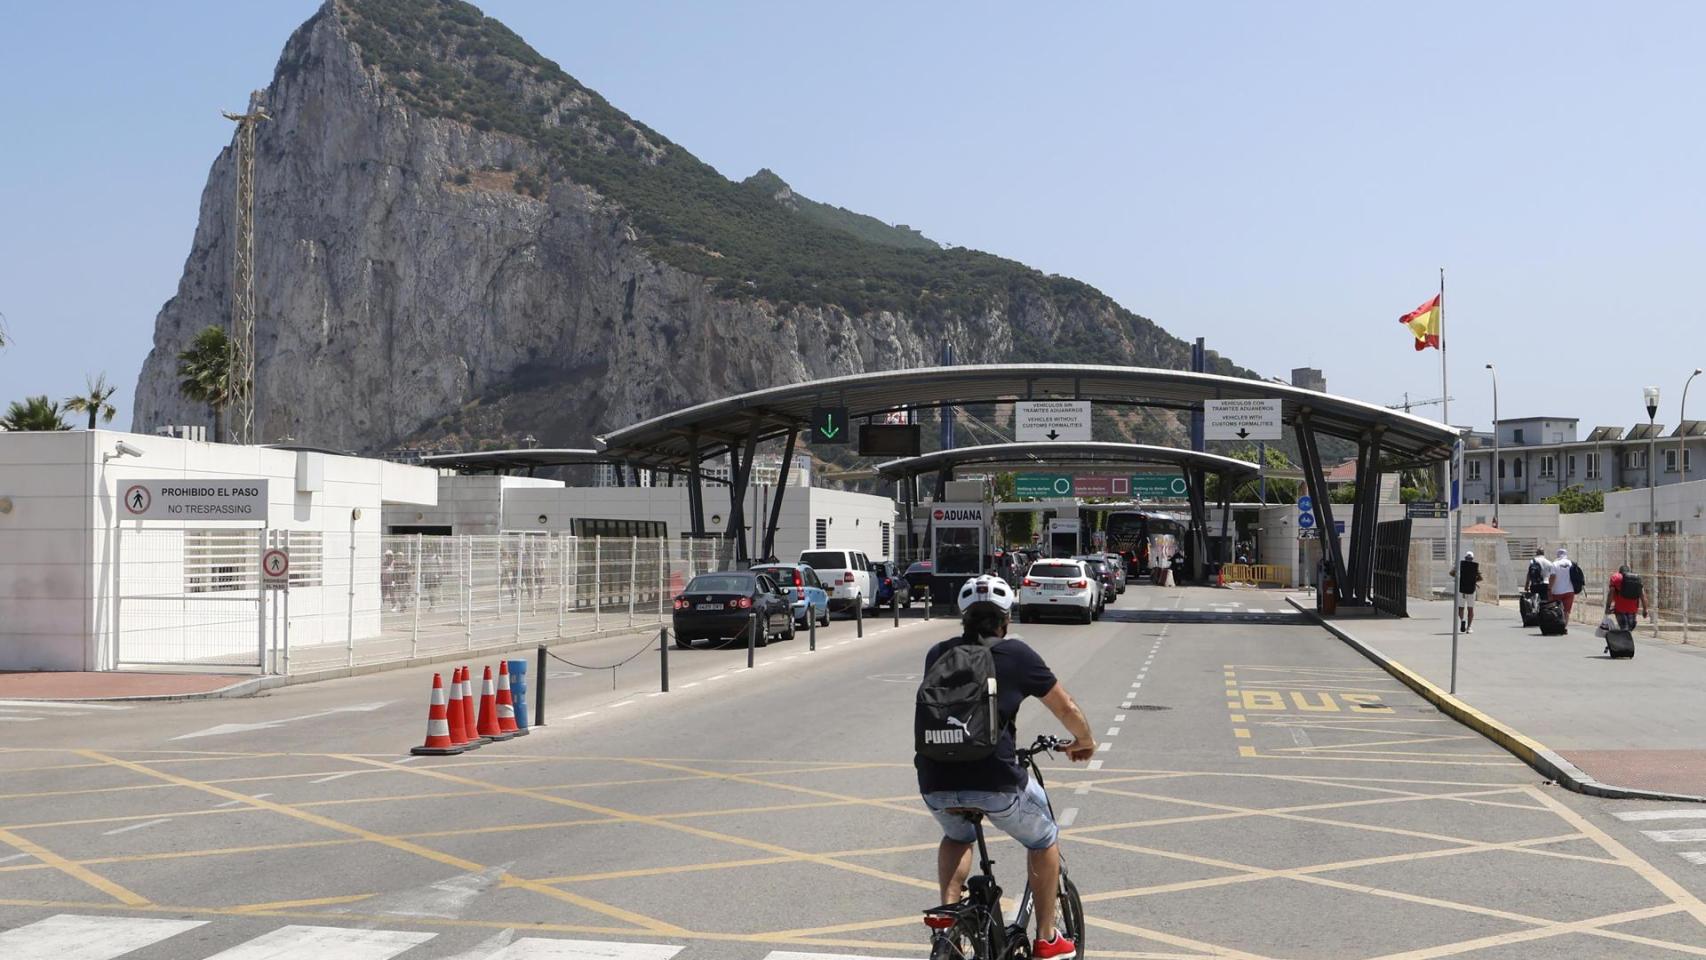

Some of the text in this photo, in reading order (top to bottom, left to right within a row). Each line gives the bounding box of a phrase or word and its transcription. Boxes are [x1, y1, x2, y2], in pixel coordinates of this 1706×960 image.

[161, 488, 258, 496] PROHIBIDO EL PASO
[168, 504, 252, 514] NO TRESPASSING
[944, 510, 982, 520] ADUANA
[1240, 690, 1396, 714] BUS
[925, 729, 964, 744] PUMA
